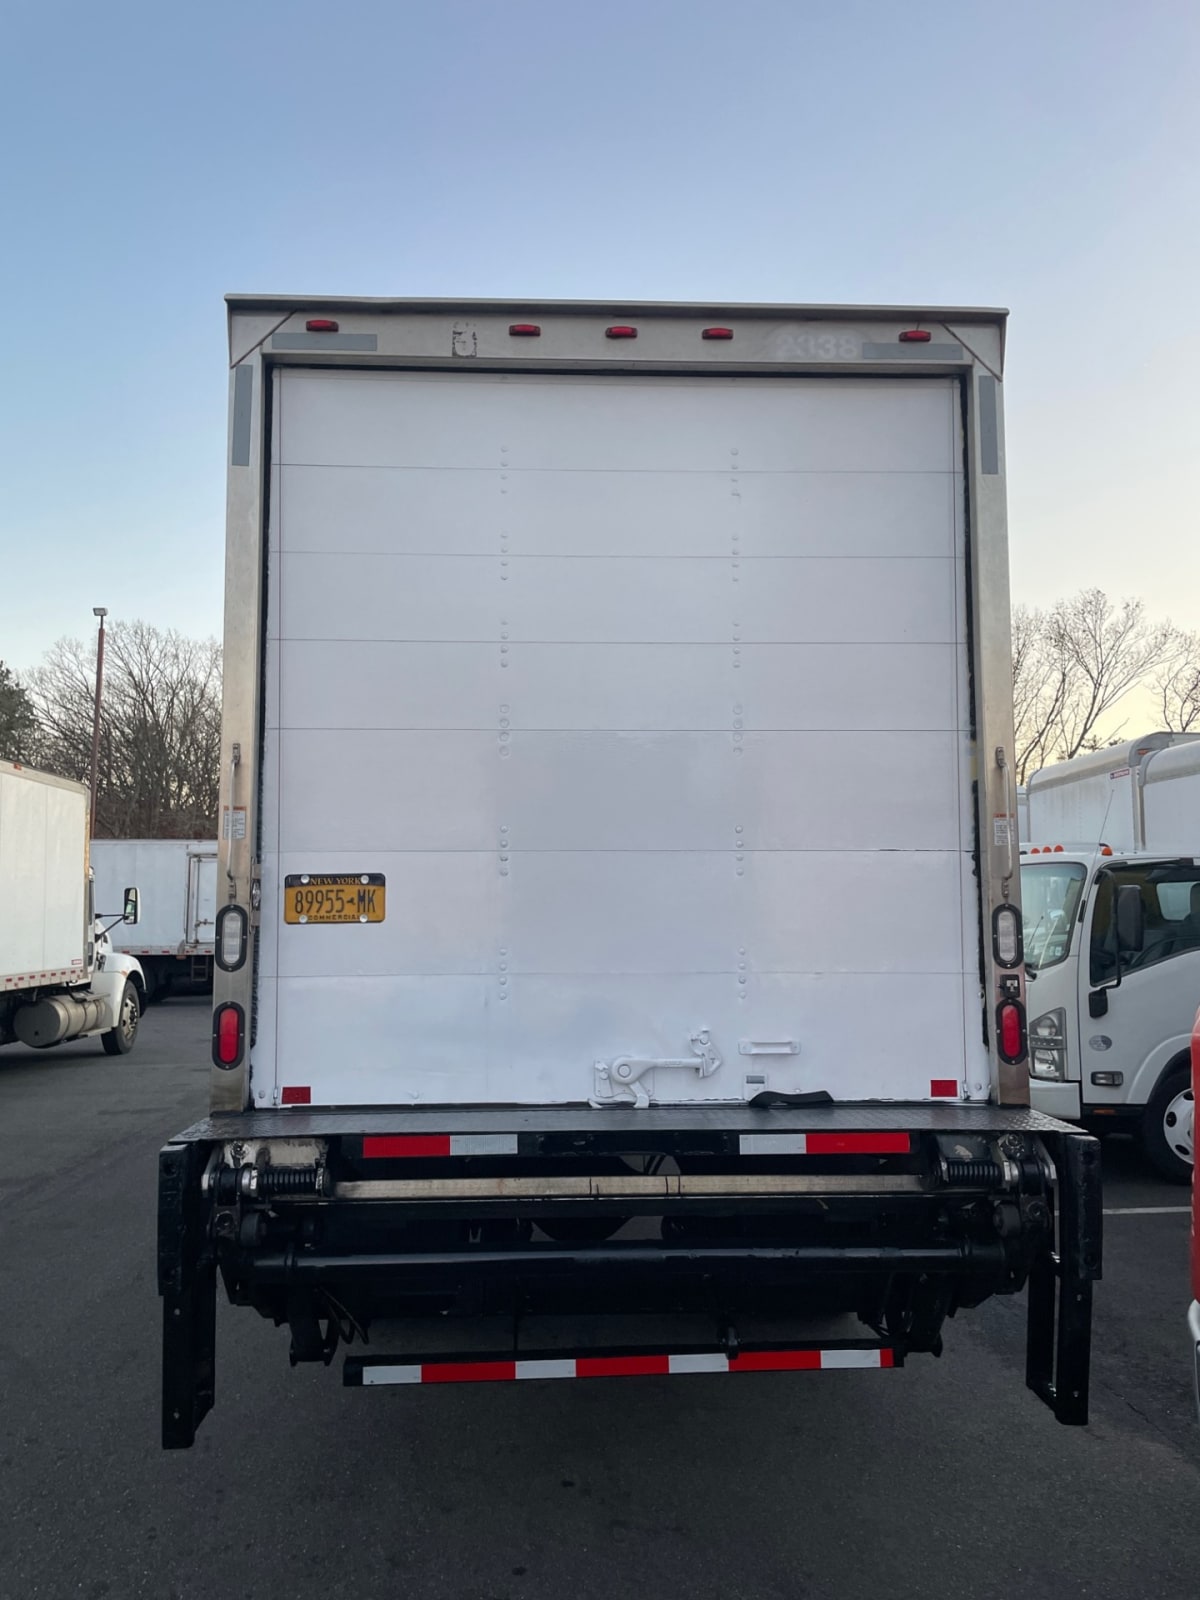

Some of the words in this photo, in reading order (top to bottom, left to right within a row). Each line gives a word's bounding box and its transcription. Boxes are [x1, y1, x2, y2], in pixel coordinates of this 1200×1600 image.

[310, 877, 332, 885] NEW
[336, 877, 361, 885] YORK
[295, 889, 345, 914] 89955
[357, 888, 376, 913] MK
